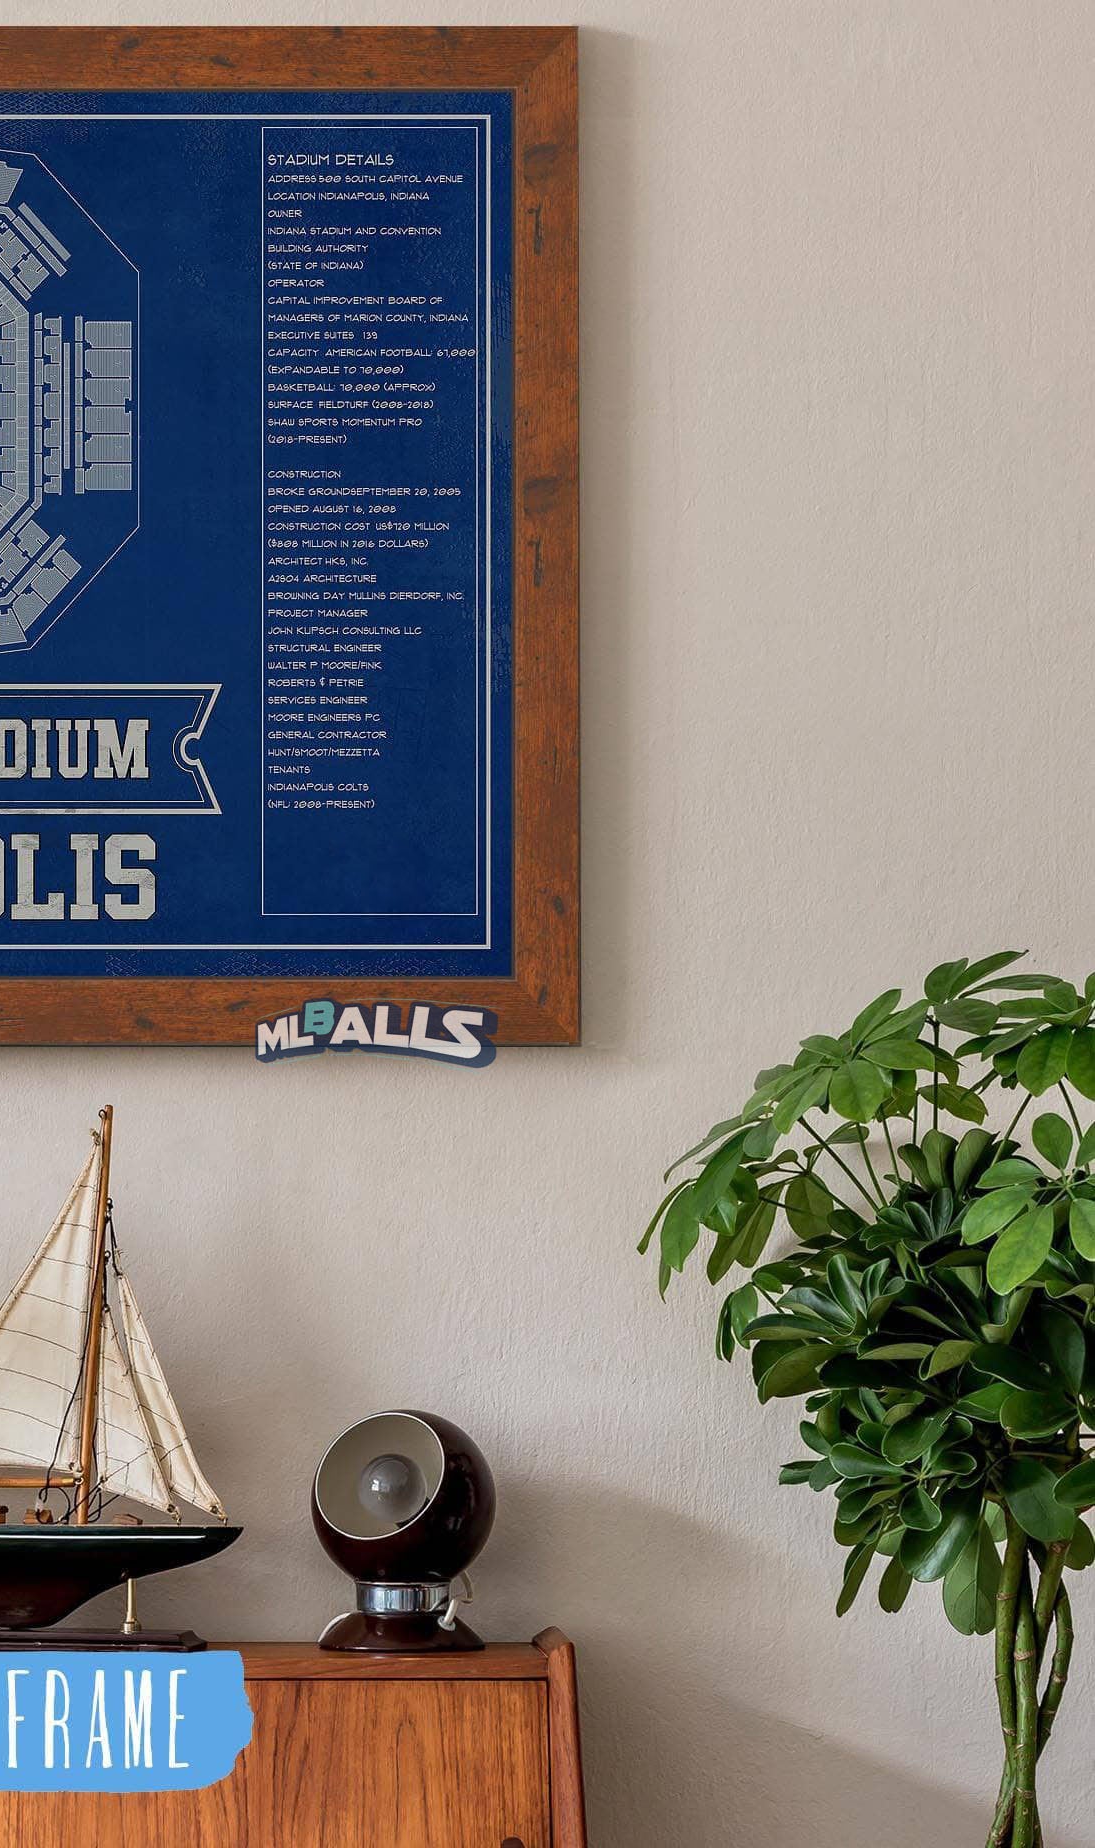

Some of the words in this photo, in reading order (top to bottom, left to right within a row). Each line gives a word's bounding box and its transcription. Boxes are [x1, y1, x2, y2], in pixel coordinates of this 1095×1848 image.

[267, 153, 330, 166] STADIUM
[335, 153, 395, 166] DETAILS
[344, 174, 376, 183] SOUTH
[378, 174, 422, 183] CAPITOL
[424, 174, 464, 183] AVENUE
[267, 191, 316, 201] LOCATION
[318, 191, 388, 201] INDIANAPOLIS,
[390, 191, 430, 201] INDIANA
[267, 209, 303, 218] OWNER
[267, 226, 307, 236] INDIANA
[309, 226, 352, 236] STADIUM
[354, 226, 377, 236] AND
[379, 226, 442, 236] CONVENTION
[267, 244, 312, 253] BUILDING
[314, 244, 369, 253] AUTHORITY
[267, 260, 302, 270] (STATE
[304, 260, 318, 270] OF
[320, 260, 364, 270] INDIANA)
[267, 278, 325, 288] OPERATOR
[267, 296, 311, 305] CAPITAL
[313, 296, 385, 305] IMPROVEMENT
[388, 296, 427, 305] BOARD
[429, 296, 443, 305] OF
[268, 313, 325, 323] MANAGERS
[327, 313, 341, 323] OF
[344, 313, 383, 323] MARION
[385, 313, 427, 323] COUNTY,
[429, 313, 469, 323] INDIANA
[267, 331, 321, 340] EXECUTIVE
[323, 331, 355, 340] SUITES
[362, 331, 378, 340] 139
[267, 348, 320, 357] CAPACITY
[324, 348, 377, 357] AMERICAN
[436, 348, 476, 357] 67,000
[267, 364, 340, 375] (EXPANDABLE
[343, 364, 357, 374] TO
[359, 364, 404, 375] 70,000)
[339, 382, 381, 392] 70,000
[267, 399, 314, 409] SURFACE
[318, 399, 369, 409] FIELDTURF
[371, 399, 434, 409] (2008-2018)
[267, 417, 295, 427] SHAW
[298, 417, 339, 427] SPORTS
[341, 417, 396, 427] MOMENTUM
[398, 417, 423, 427] PRO
[267, 434, 348, 444] (2018-PRESENT)
[267, 470, 342, 479] CONSTRUCTION
[267, 487, 305, 496] BROKE
[414, 487, 430, 496] 20,
[433, 487, 461, 496] 2005
[267, 504, 310, 514] OPENED
[312, 504, 350, 514] AUGUST
[352, 504, 365, 514] 16,
[368, 504, 397, 514] 2008
[267, 521, 342, 531] CONSTRUCTION
[344, 521, 371, 531] COST
[375, 521, 411, 531] US$720
[414, 521, 450, 531] MILLION
[267, 538, 299, 549] ($808
[301, 538, 338, 548] MILLION
[340, 538, 349, 548] IN
[352, 538, 376, 548] 2016
[378, 538, 429, 548] DOLLARS)
[267, 557, 323, 566] ARCHITECT
[325, 557, 348, 566] HKS,
[351, 557, 369, 566] INC.
[303, 574, 377, 583] ARCHITECTURE
[267, 591, 320, 601] BROWNING
[323, 591, 346, 601] DAY
[348, 591, 387, 601] MULLINS
[389, 591, 444, 601] DIERDORF,
[446, 591, 465, 601] INC.
[267, 609, 314, 618] PROJECT
[317, 609, 368, 618] MANAGER
[267, 626, 293, 635] JOHN
[296, 626, 339, 635] KLIPSCH
[341, 626, 401, 635] CONSULTING
[403, 626, 422, 635] LLC
[267, 643, 331, 653] STRUCTURAL
[333, 643, 382, 653] ENGINEER
[267, 661, 307, 670] WALTER
[309, 661, 319, 670] P
[321, 661, 382, 670] MOORE/FINK
[267, 677, 316, 687] ROBERTS
[319, 677, 326, 687] &
[328, 677, 364, 687] PETRIE
[267, 696, 317, 705] SERVICES
[319, 696, 368, 705] ENGINEER
[267, 713, 305, 722] MOORE
[307, 713, 362, 722] ENGINEERS
[364, 713, 381, 722] PC
[267, 730, 315, 739] GENERAL
[317, 730, 387, 739] CONTRACTOR
[267, 748, 380, 757] HUNT/SMOOT/MEZZETTA
[268, 765, 311, 774] TENANTS
[267, 782, 335, 792] INDIANAPOLIS
[337, 782, 369, 792] COLTS
[293, 799, 375, 809] 2008-PRESENT)
